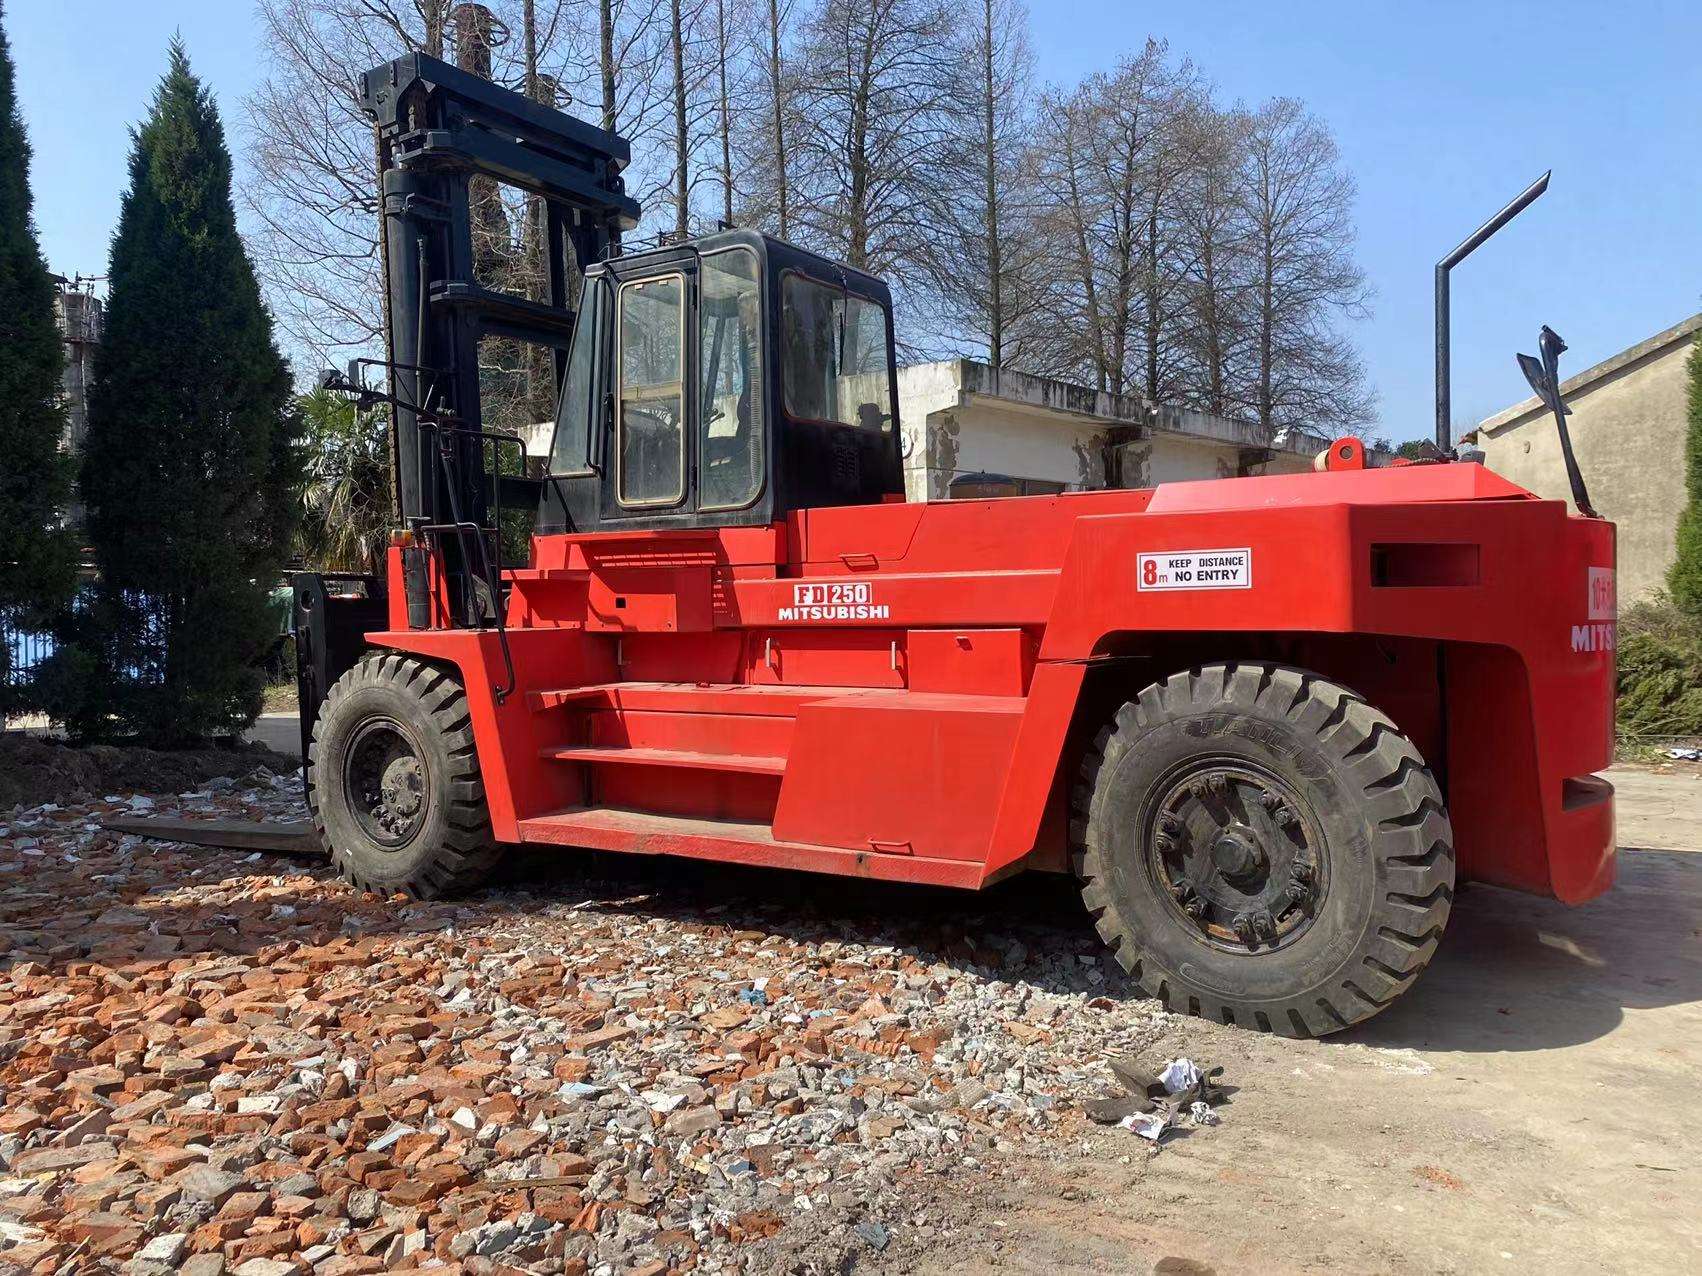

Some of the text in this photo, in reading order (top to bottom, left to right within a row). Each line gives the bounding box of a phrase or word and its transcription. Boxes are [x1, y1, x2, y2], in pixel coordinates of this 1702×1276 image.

[1169, 559, 1192, 568] KEEP
[1199, 557, 1244, 567] DISTANCE
[1175, 569, 1239, 582] NO ENTRY
[778, 605, 890, 620] MITSUBISHI
[1571, 625, 1616, 652] MITS
